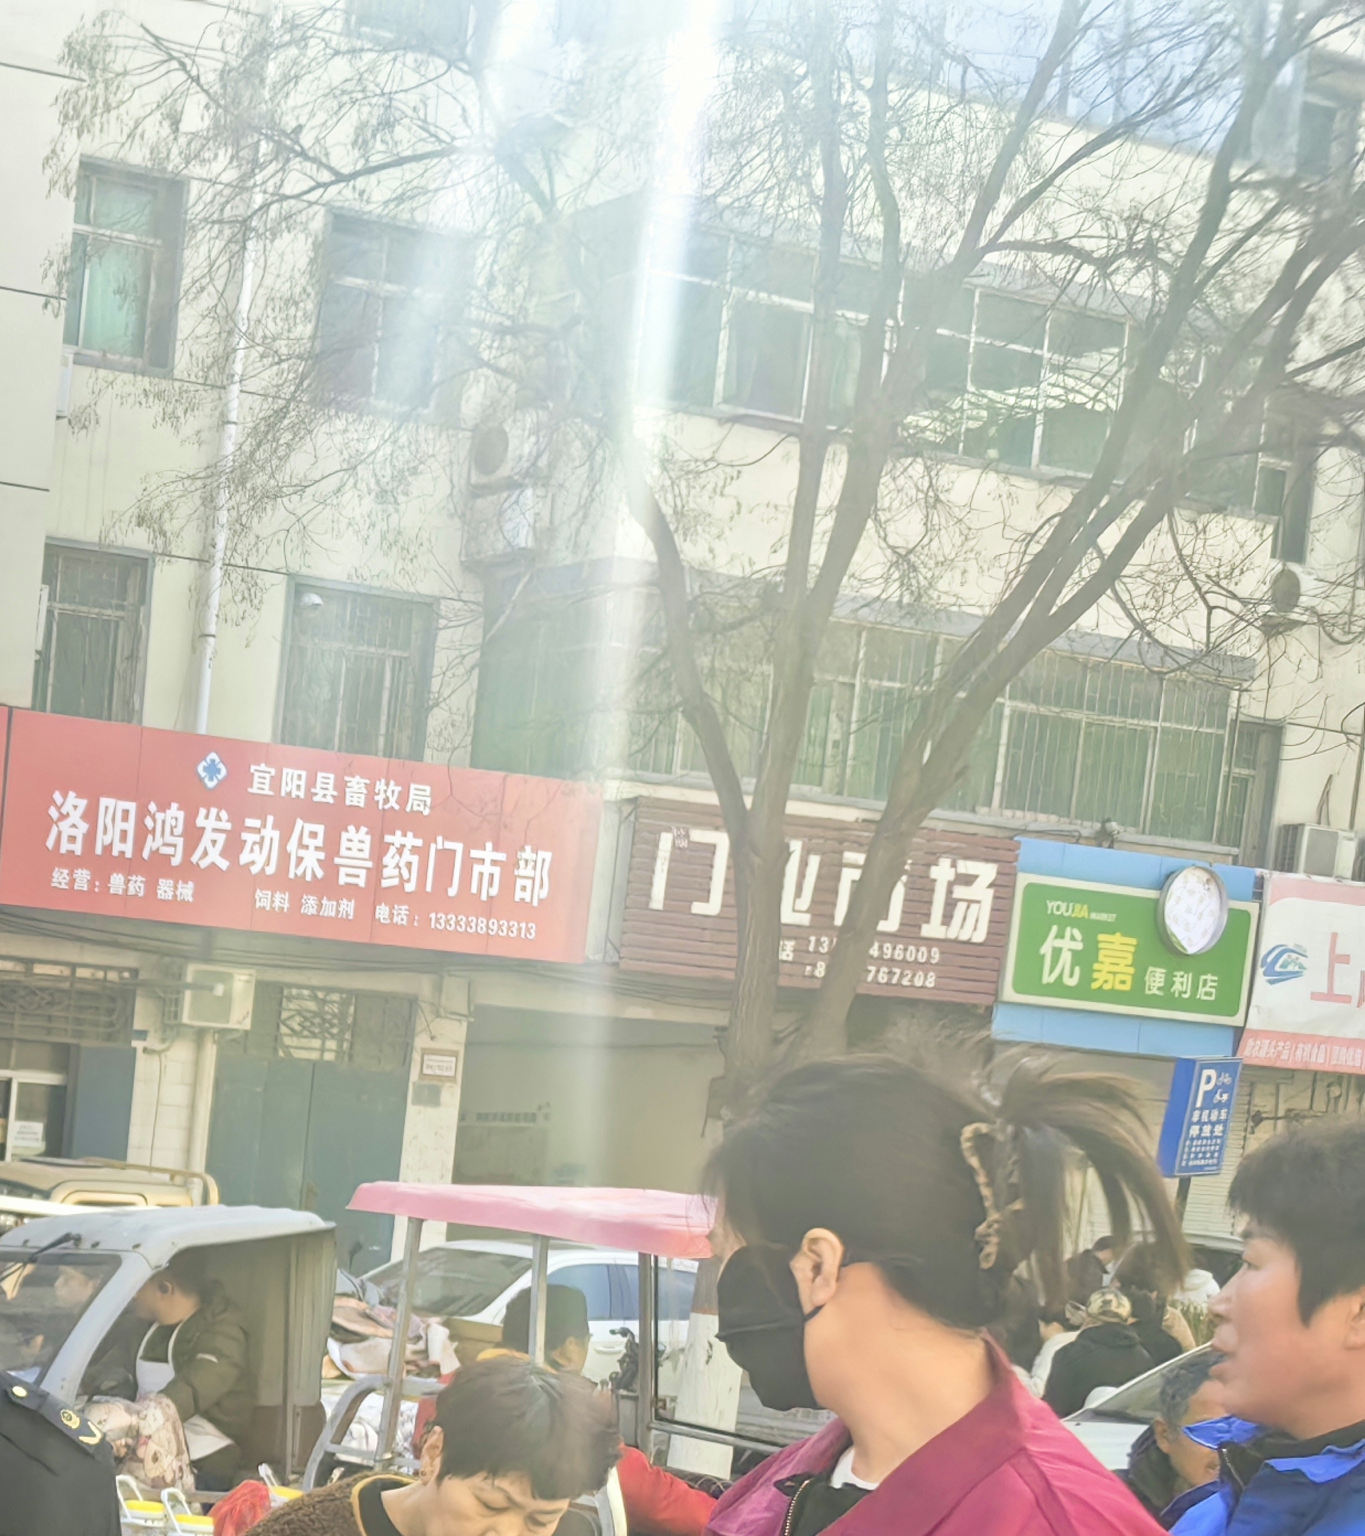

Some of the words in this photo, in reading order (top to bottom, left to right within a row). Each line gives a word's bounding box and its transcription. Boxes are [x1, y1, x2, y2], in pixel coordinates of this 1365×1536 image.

[247, 763, 432, 817] 宜阳县畜牧局
[45, 790, 552, 907] 洛阳鸿发动保兽药门市部
[157, 878, 195, 902] 器械
[255, 888, 290, 912] 饲料
[301, 894, 355, 920] 添加剂
[1039, 925, 1138, 991] 优嘉
[1144, 966, 1218, 1000] 便利店
[1310, 932, 1365, 1007] 上
[1195, 1069, 1217, 1108] P
